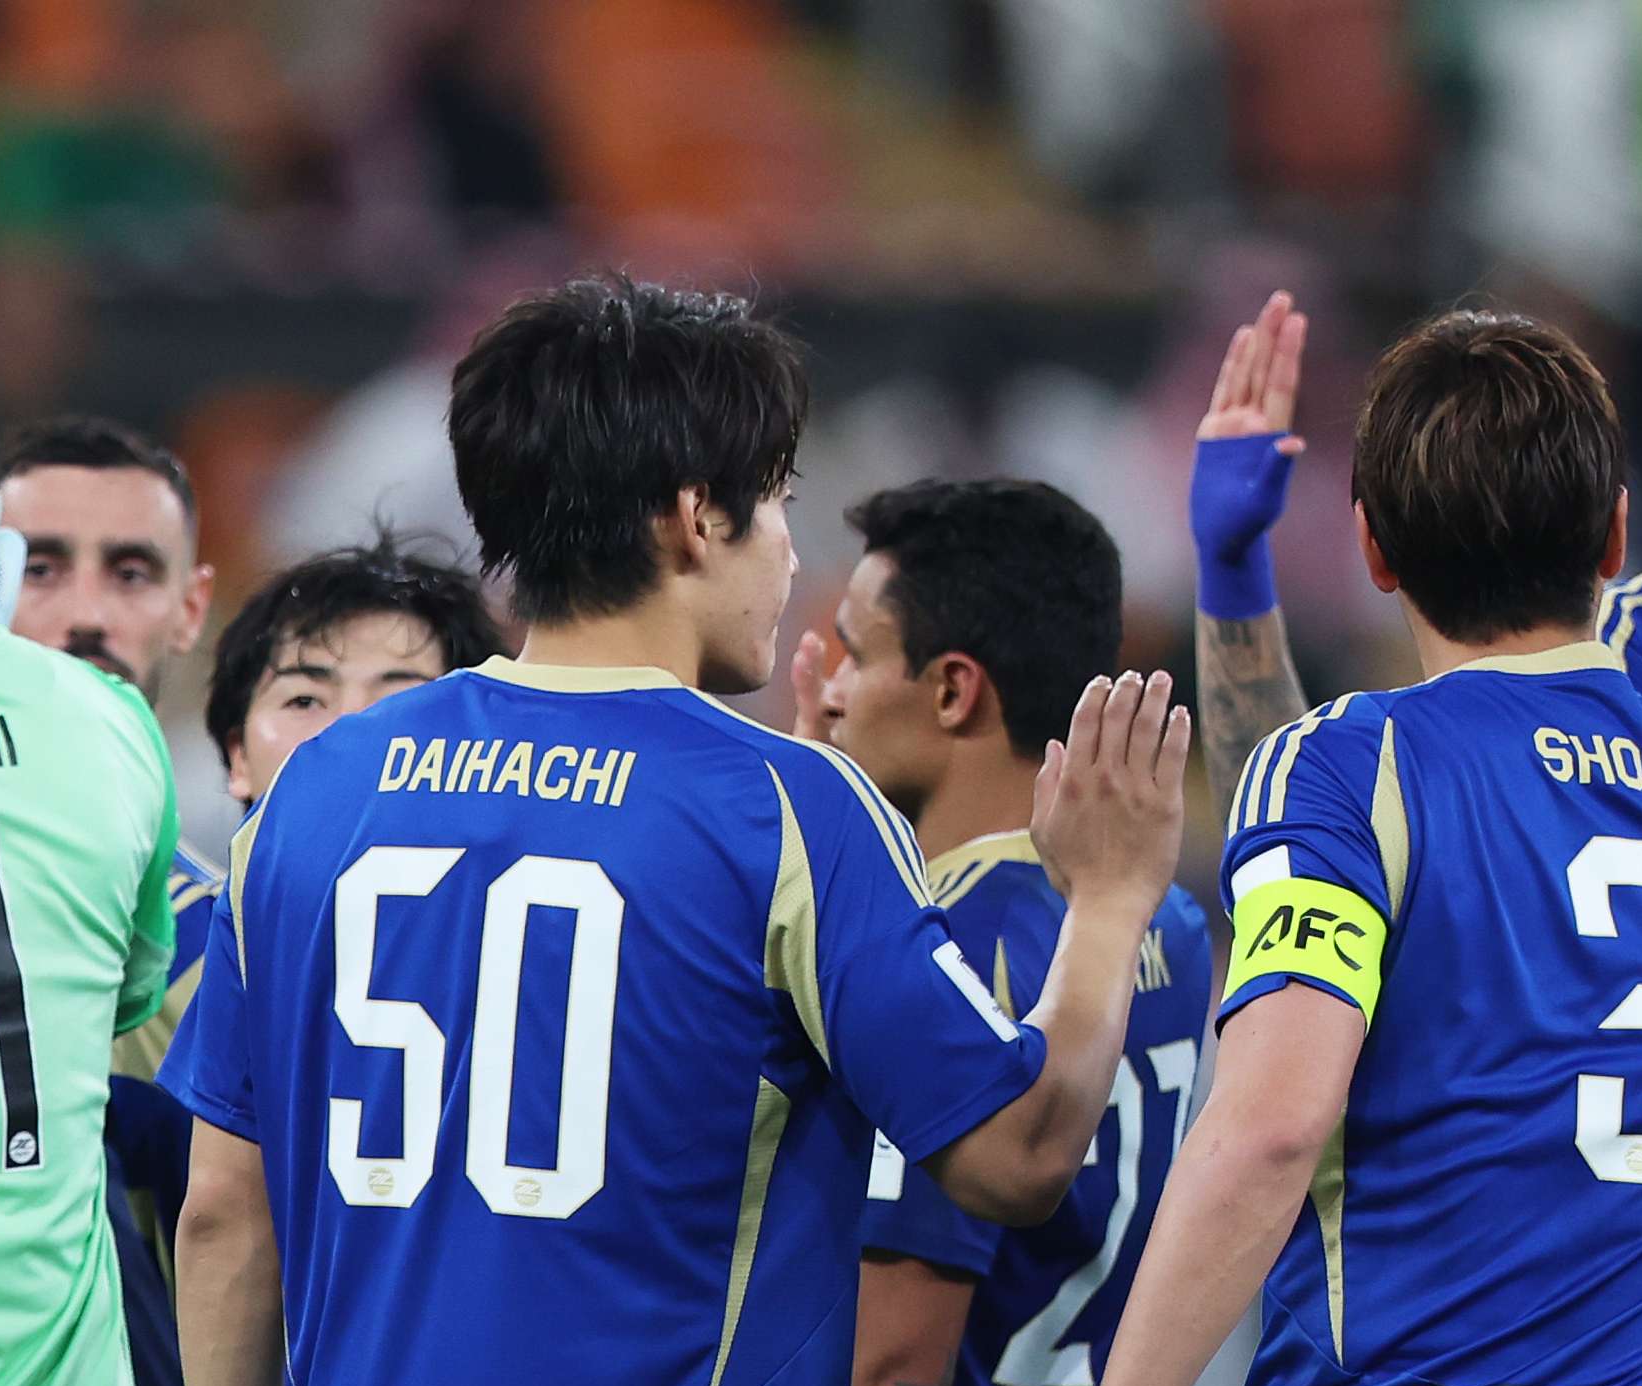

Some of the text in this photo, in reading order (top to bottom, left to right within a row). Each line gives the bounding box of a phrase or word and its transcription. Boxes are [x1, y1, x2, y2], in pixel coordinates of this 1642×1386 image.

[377, 736, 636, 807] DAIHACHI
[1245, 904, 1367, 971] AFC
[327, 845, 625, 1220] 50
